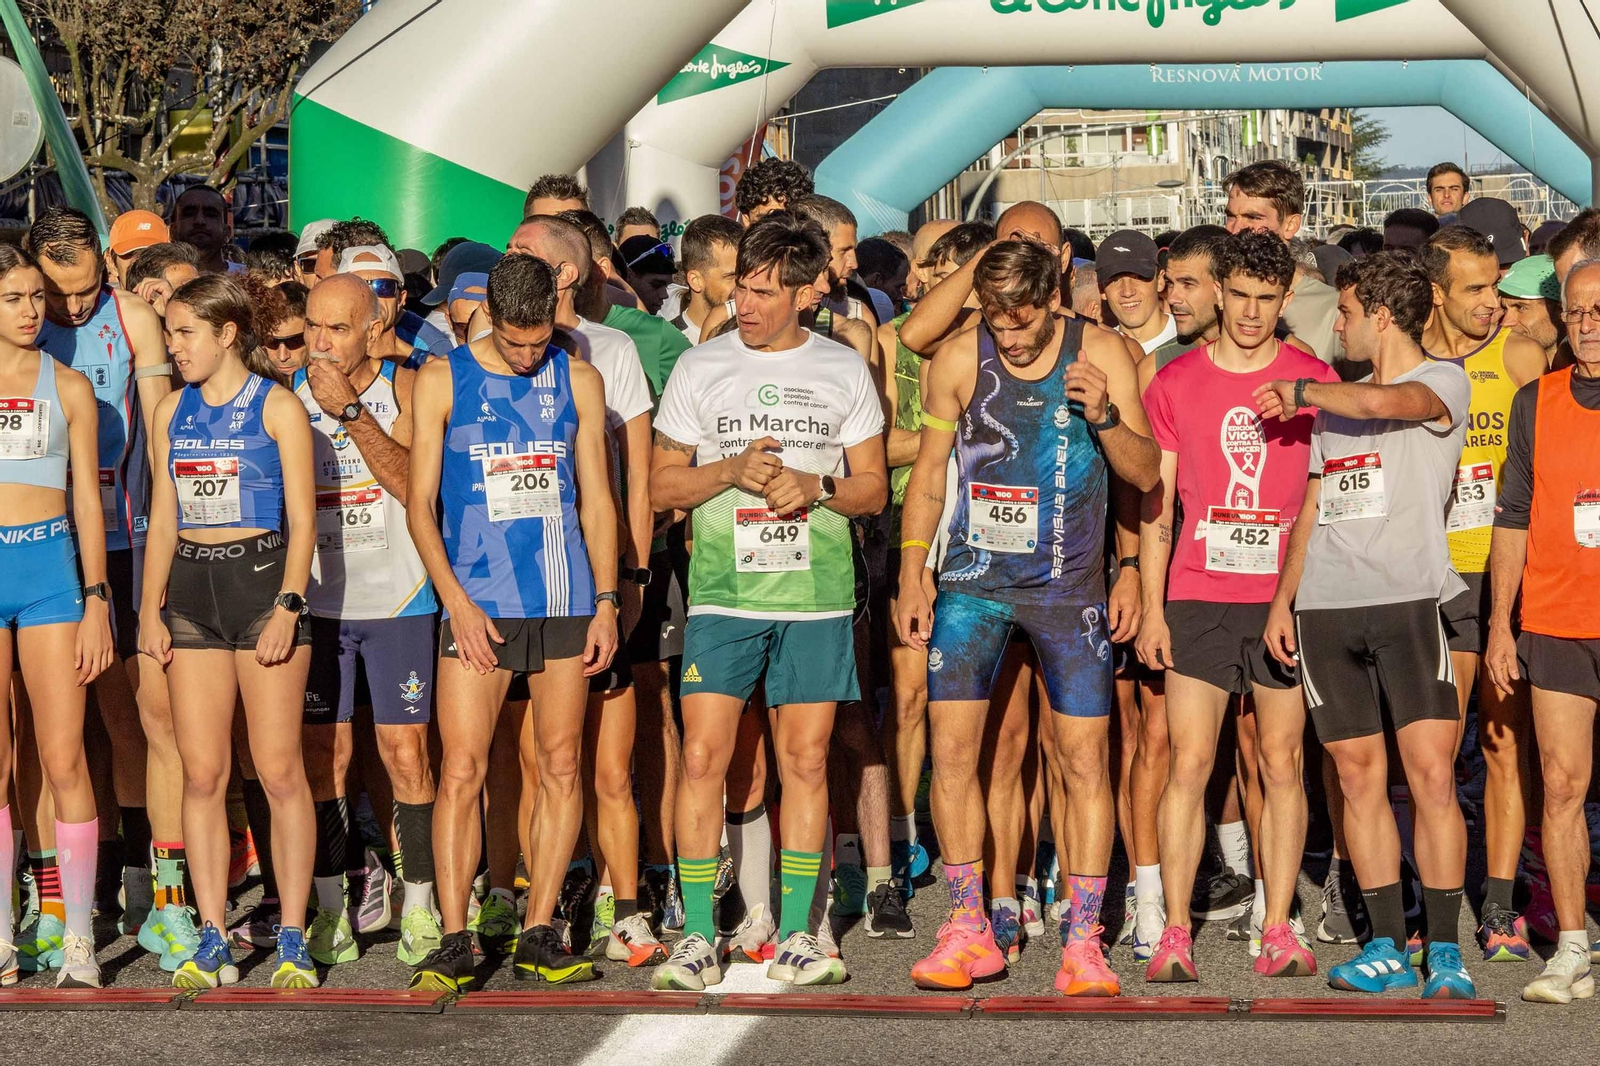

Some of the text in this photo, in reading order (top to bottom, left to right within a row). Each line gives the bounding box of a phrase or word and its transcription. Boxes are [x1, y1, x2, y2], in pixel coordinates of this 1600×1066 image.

[1151, 65, 1322, 83] RESNOVA MOTOR
[718, 414, 829, 436] En Marcha
[1233, 414, 1248, 425] VI
[173, 439, 245, 450] SOLISS
[781, 437, 814, 449] áncer
[1228, 431, 1258, 440] VIGO
[469, 441, 566, 461] SOLISS
[1055, 436, 1068, 488] BUEU
[193, 479, 228, 496] 207
[510, 473, 550, 492] 206
[1339, 472, 1370, 492] 615
[336, 508, 372, 526] 166
[989, 506, 1027, 524] 456
[0, 525, 46, 544] NIKE
[760, 525, 799, 543] 649
[1051, 494, 1064, 578] SERVISUB
[1230, 528, 1269, 545] 452
[195, 544, 245, 560] PRO
